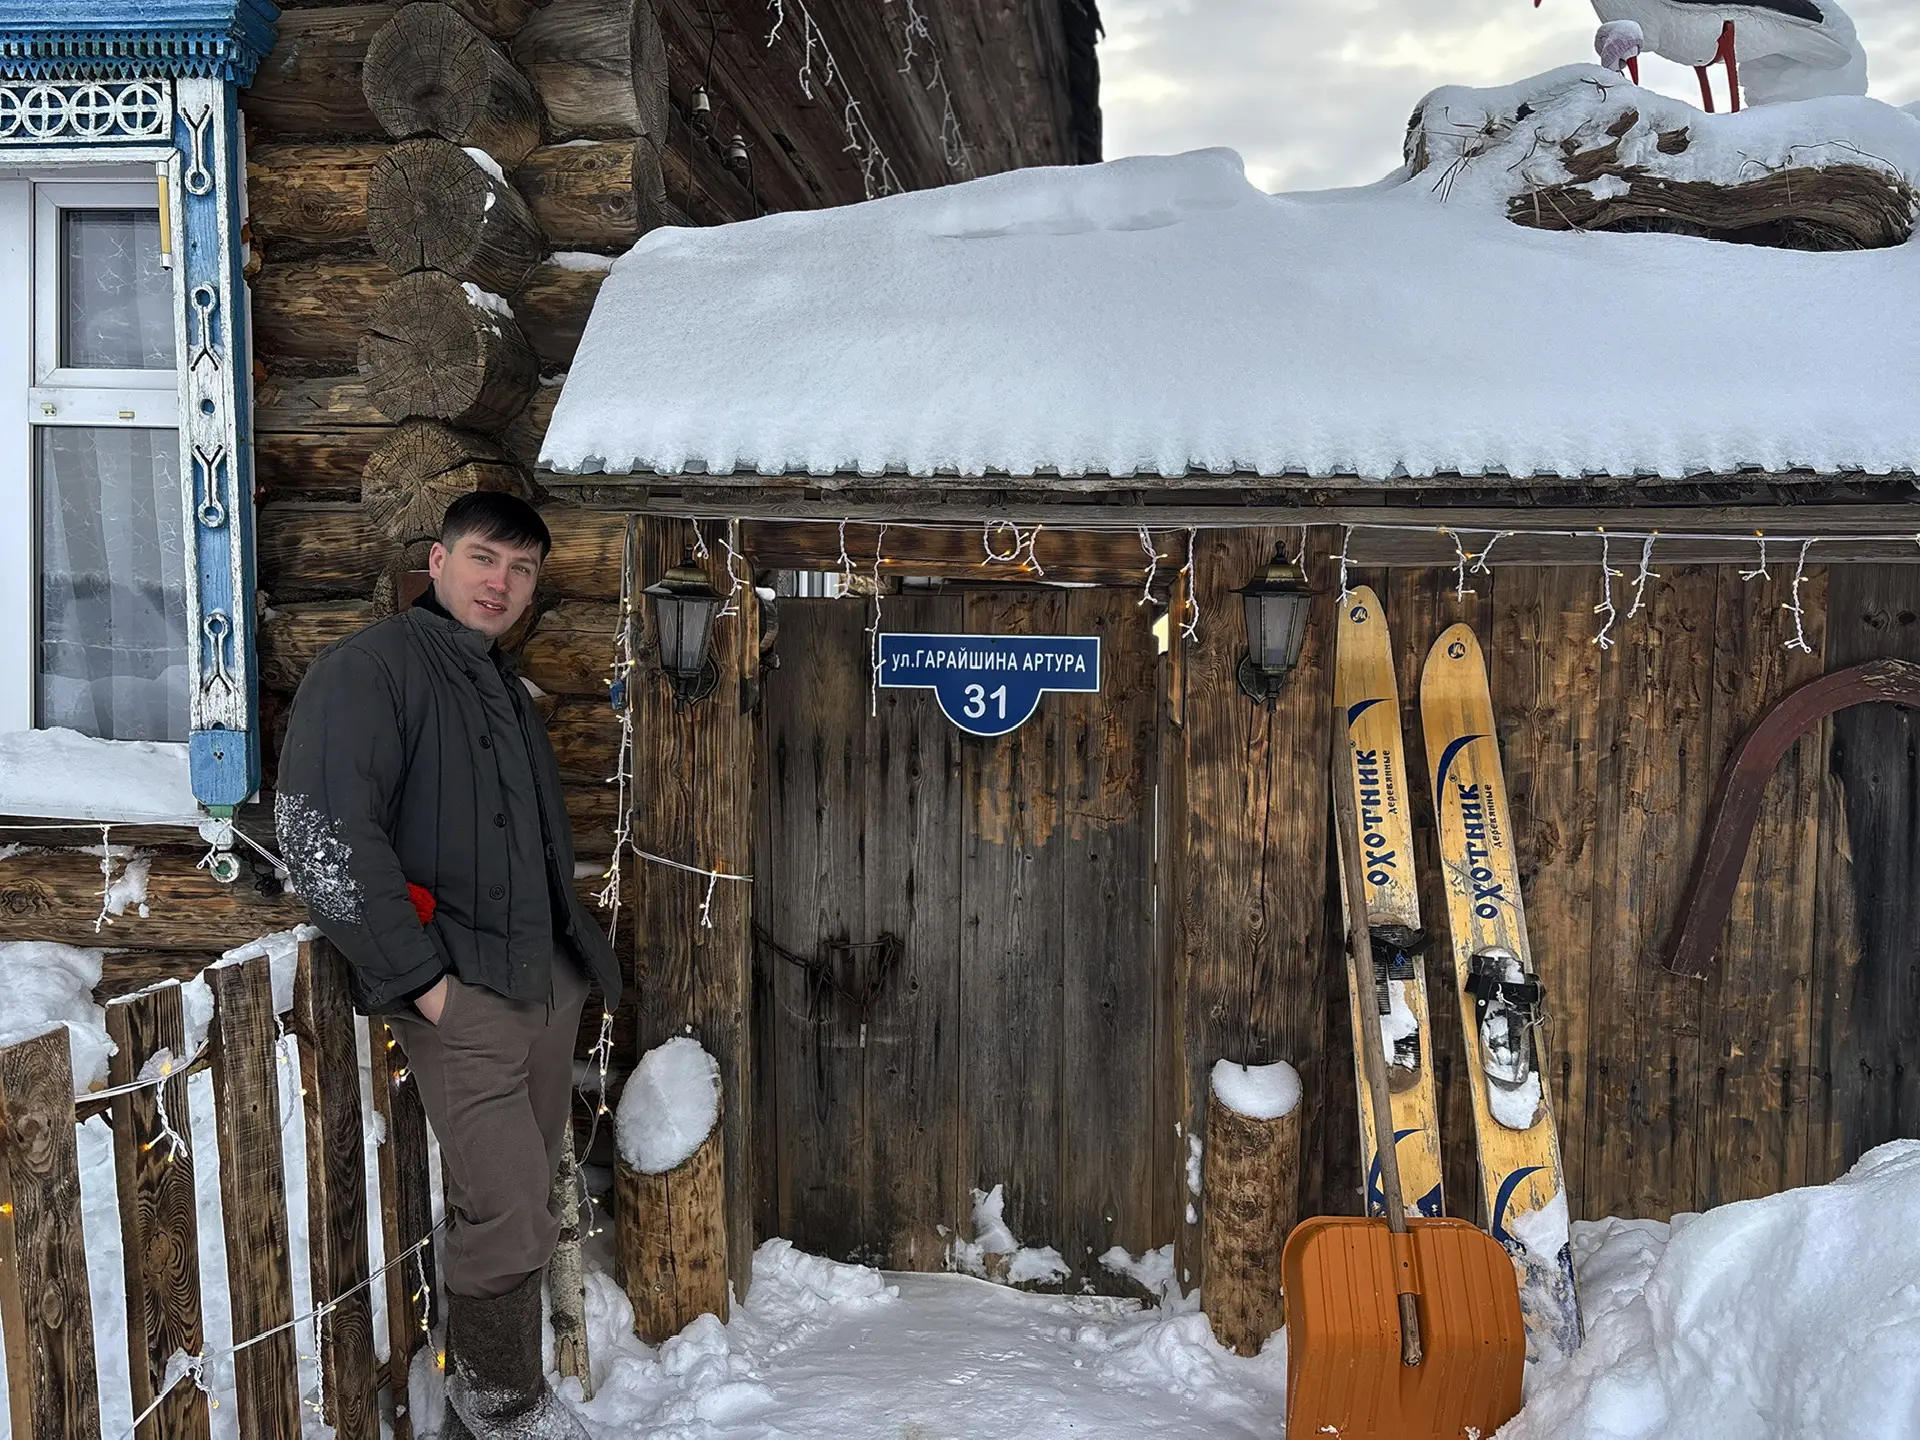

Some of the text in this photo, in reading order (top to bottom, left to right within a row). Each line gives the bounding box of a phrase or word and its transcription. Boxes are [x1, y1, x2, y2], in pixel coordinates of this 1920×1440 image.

[1023, 653, 1086, 673] АРТУРА
[963, 684, 1007, 720] 31
[1384, 750, 1397, 814] деревянные
[1356, 749, 1396, 886] ОХОТНИК
[1485, 784, 1502, 848] деревянные
[1457, 783, 1503, 919] ОХОТНИК
